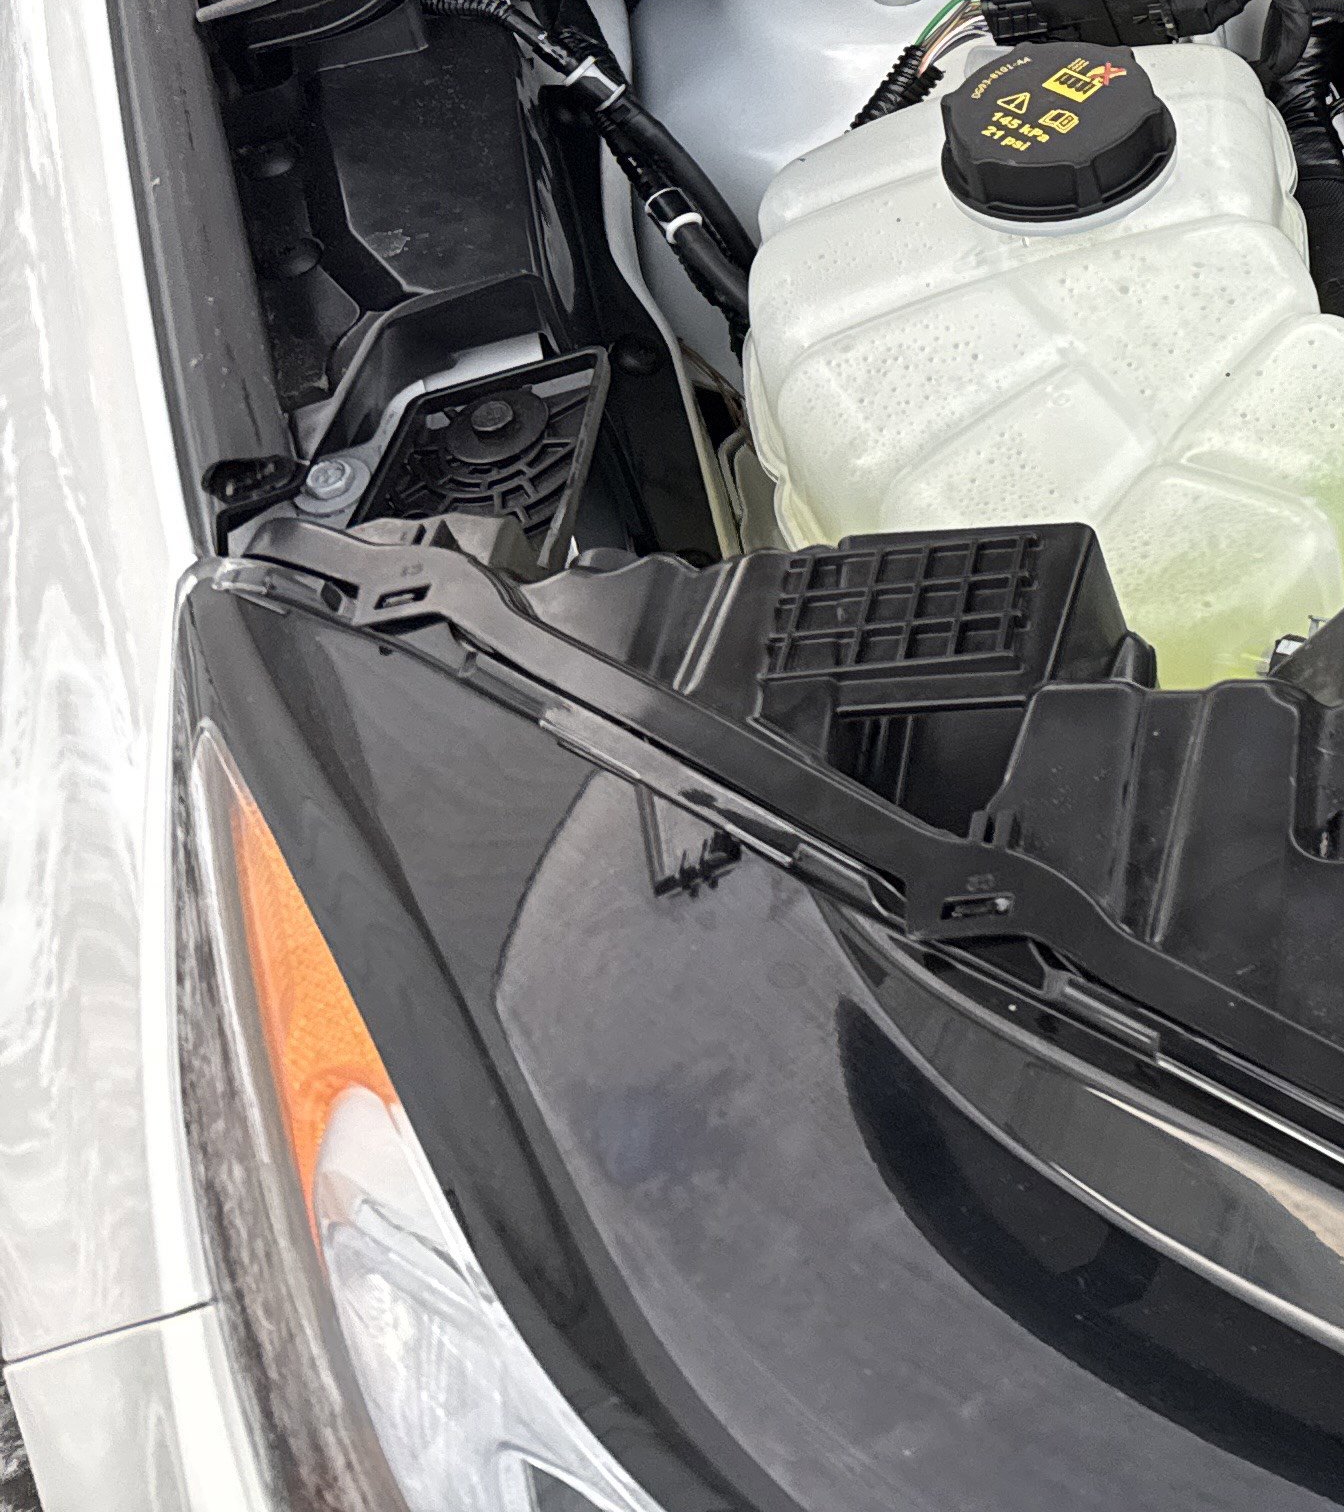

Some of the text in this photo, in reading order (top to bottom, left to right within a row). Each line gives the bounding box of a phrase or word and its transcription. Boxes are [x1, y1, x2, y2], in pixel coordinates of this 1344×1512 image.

[981, 125, 1032, 152] 21 psi
[991, 111, 1050, 144] 145 kPa
